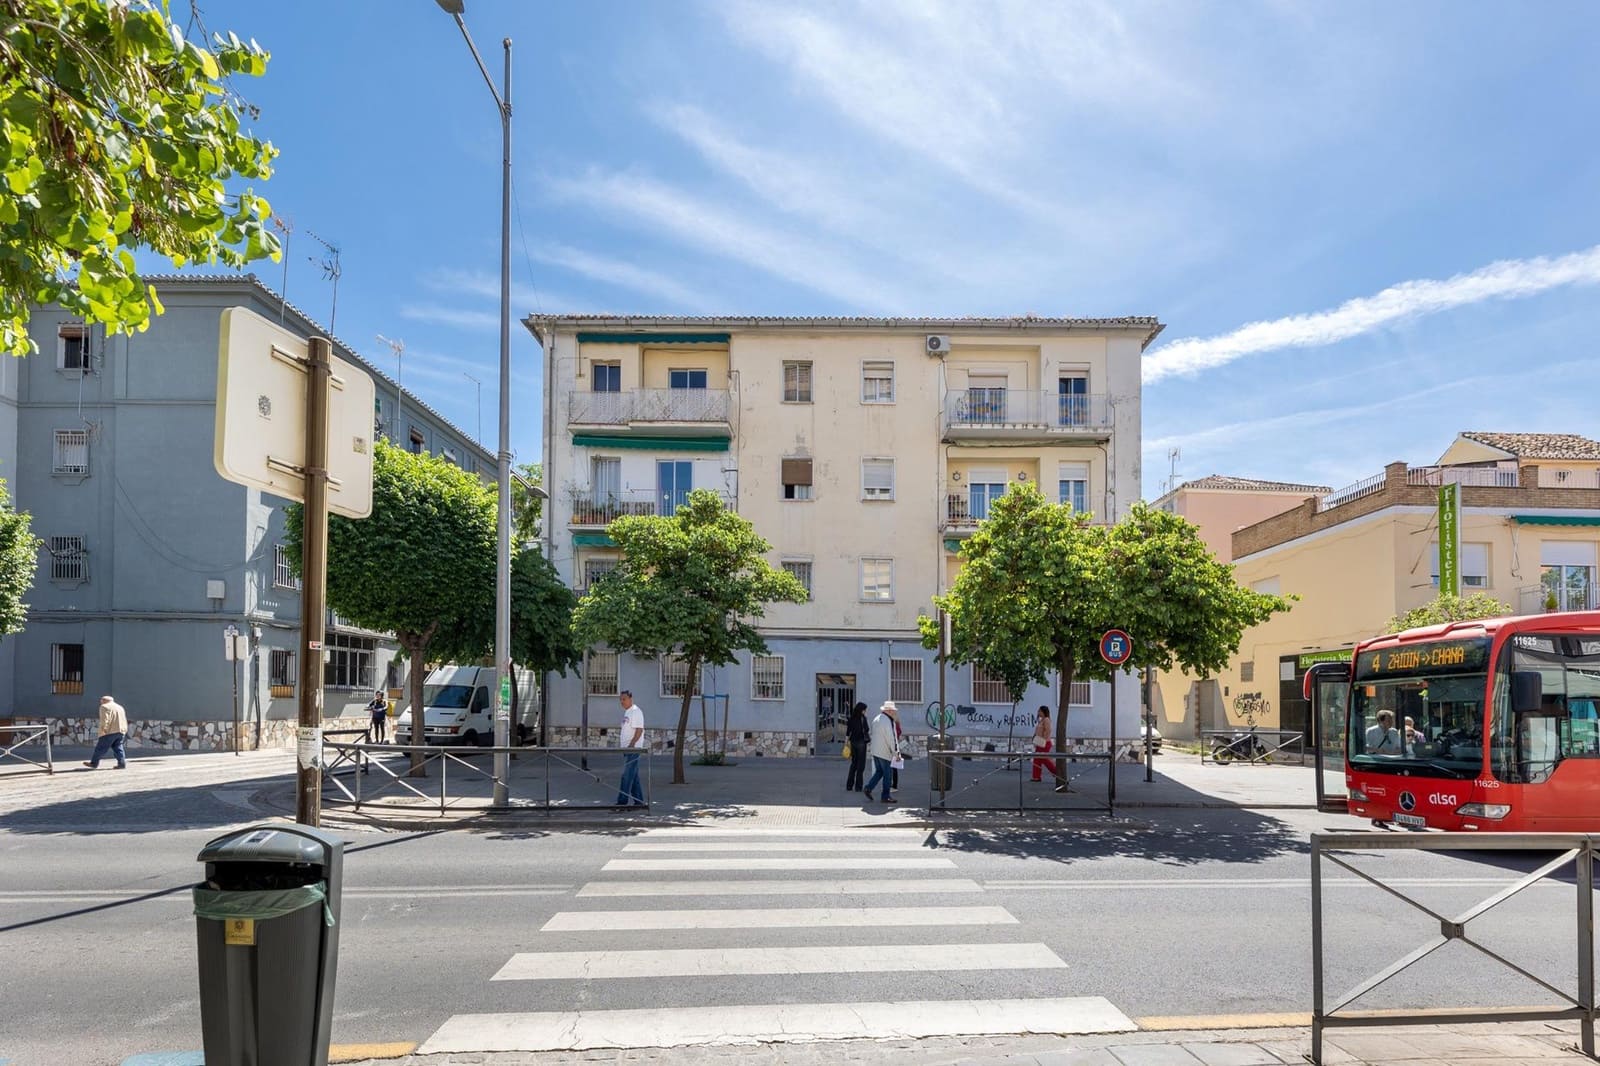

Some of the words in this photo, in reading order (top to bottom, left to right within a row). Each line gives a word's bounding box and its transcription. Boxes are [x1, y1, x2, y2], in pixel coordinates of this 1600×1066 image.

[1513, 636, 1537, 646] 11625
[1372, 654, 1380, 672] 4
[1431, 647, 1464, 665] CHANA
[1474, 780, 1500, 788] 11625
[1428, 792, 1457, 805] alsa
